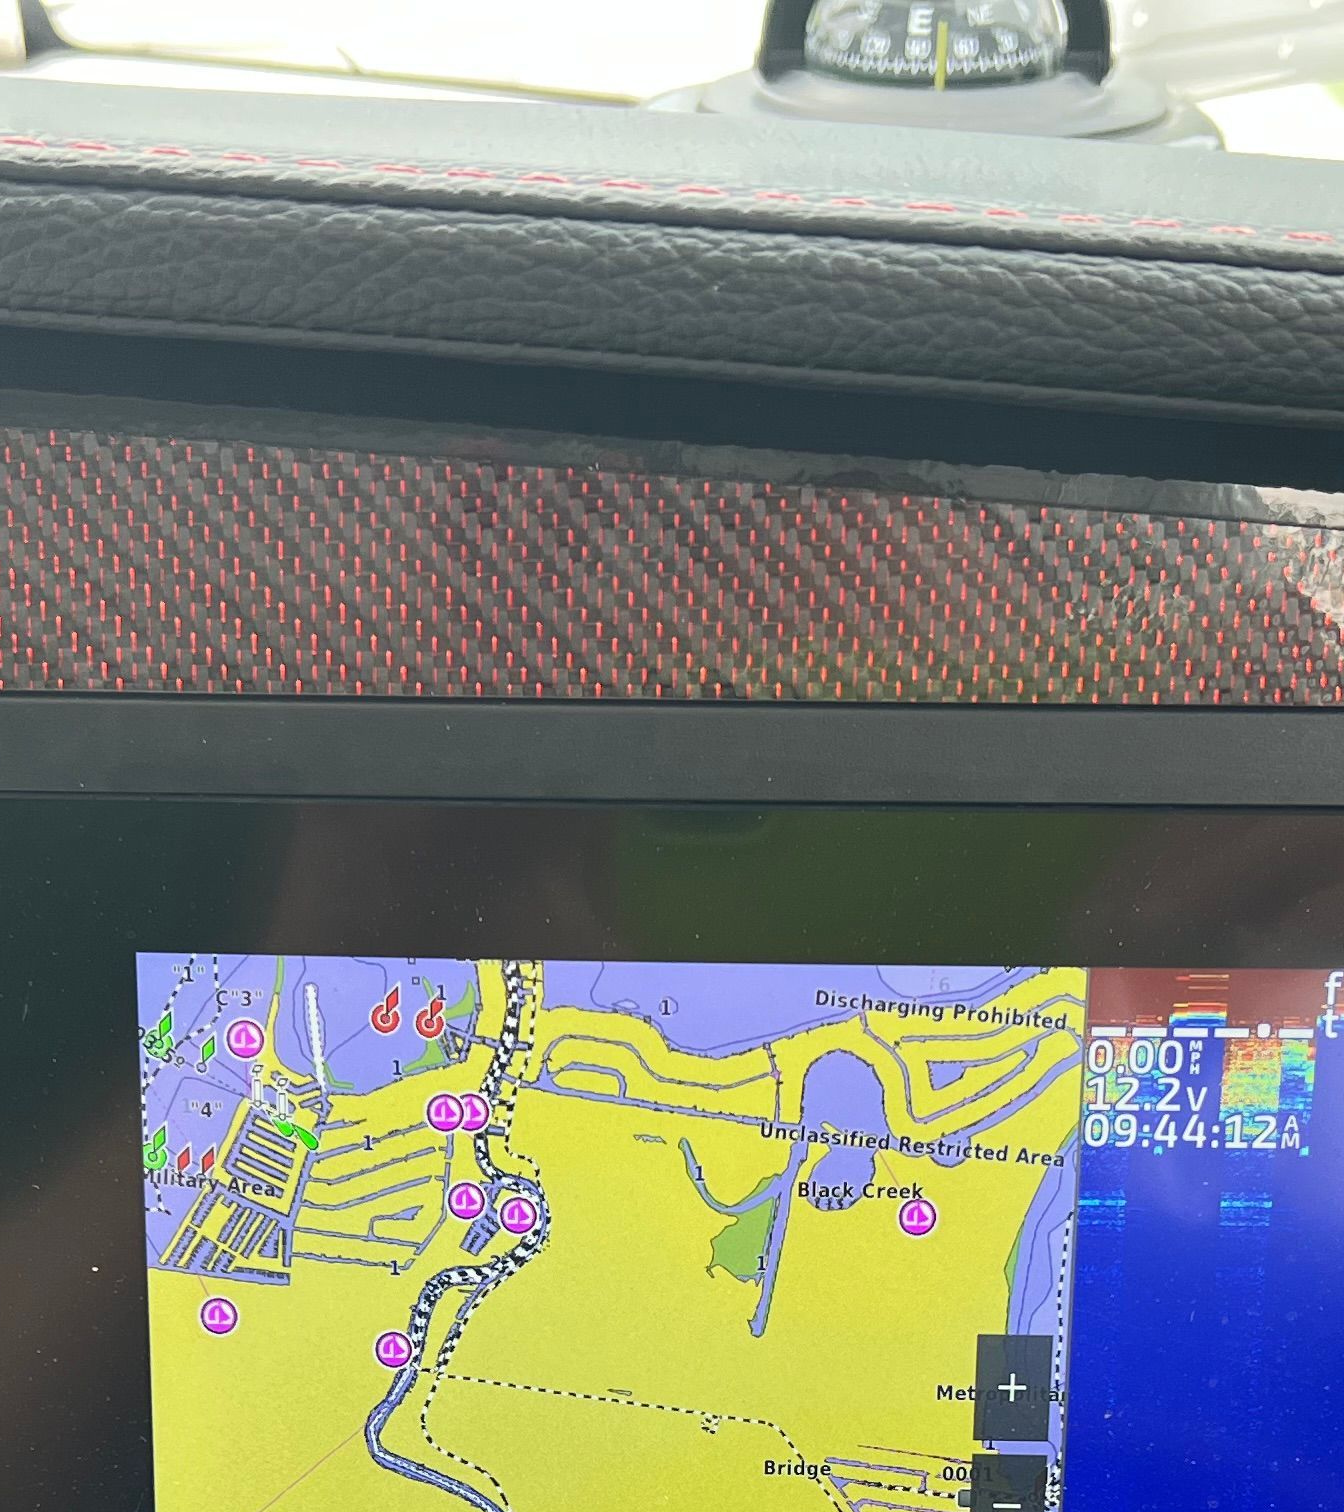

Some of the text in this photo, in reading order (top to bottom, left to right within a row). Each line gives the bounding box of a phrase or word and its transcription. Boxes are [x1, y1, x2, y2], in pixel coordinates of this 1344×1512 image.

[908, 7, 934, 36] E
[816, 990, 1067, 1030] Discharging Prohibited
[1087, 1039, 1184, 1076] 0.00
[1086, 1076, 1207, 1111] 12.2 V
[761, 1122, 1065, 1168] Unclassified Restricted Area
[1084, 1114, 1277, 1149] 09:44:12
[227, 1177, 276, 1197] Area
[798, 1181, 923, 1199] Black Creek
[764, 1461, 831, 1480] Bridge
